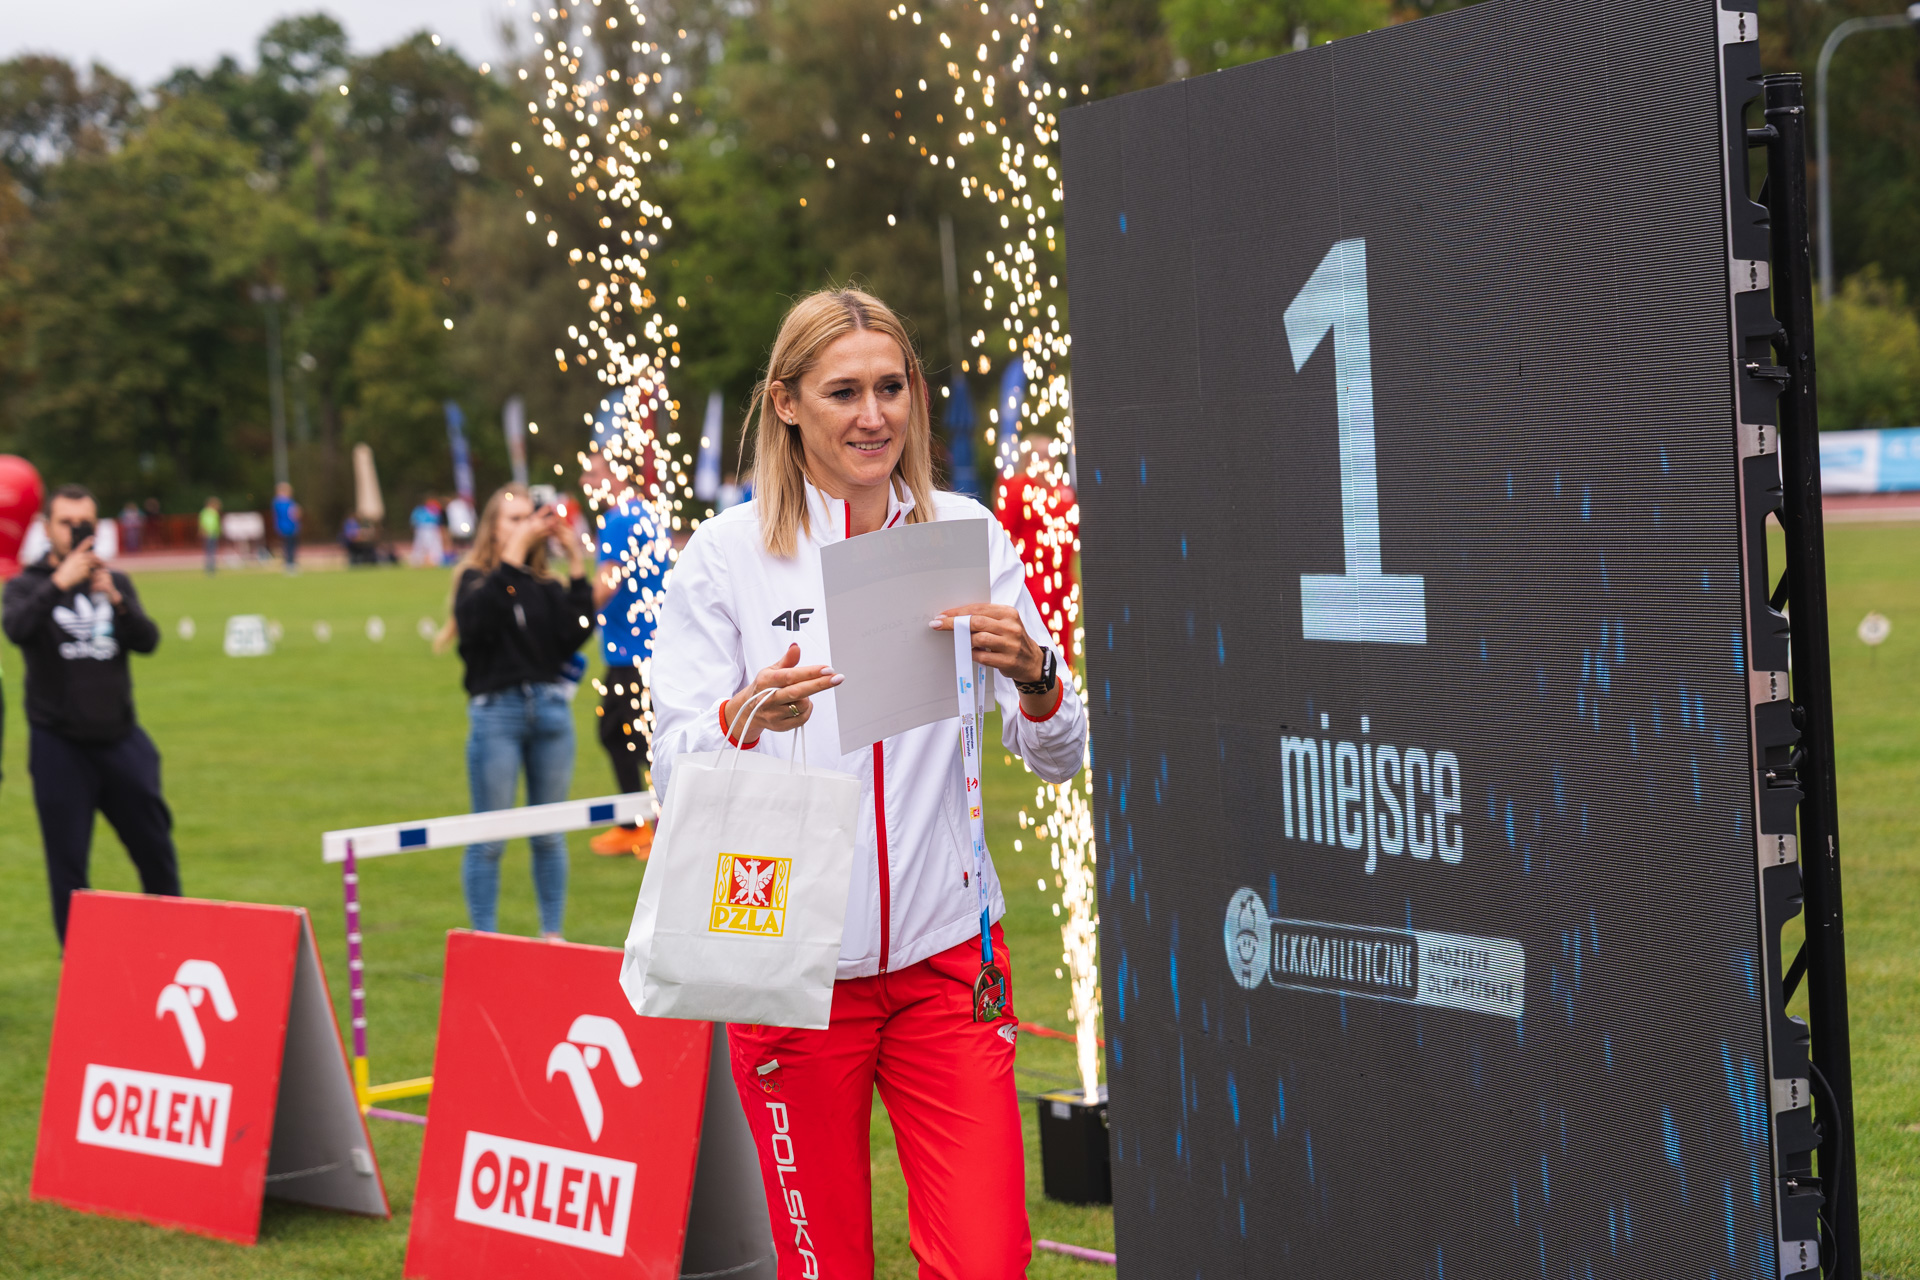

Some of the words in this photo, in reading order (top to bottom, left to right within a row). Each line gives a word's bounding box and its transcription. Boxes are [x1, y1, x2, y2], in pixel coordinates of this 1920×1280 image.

[1283, 238, 1427, 644] 1
[771, 608, 815, 632] 4F
[1280, 713, 1464, 875] miejsce
[713, 906, 780, 933] PZLA
[1273, 931, 1413, 988] LEKKOATLETYCZNE
[91, 1080, 218, 1149] ORLEN
[471, 1149, 621, 1237] ORLEN
[765, 1101, 820, 1280] POLSKA
